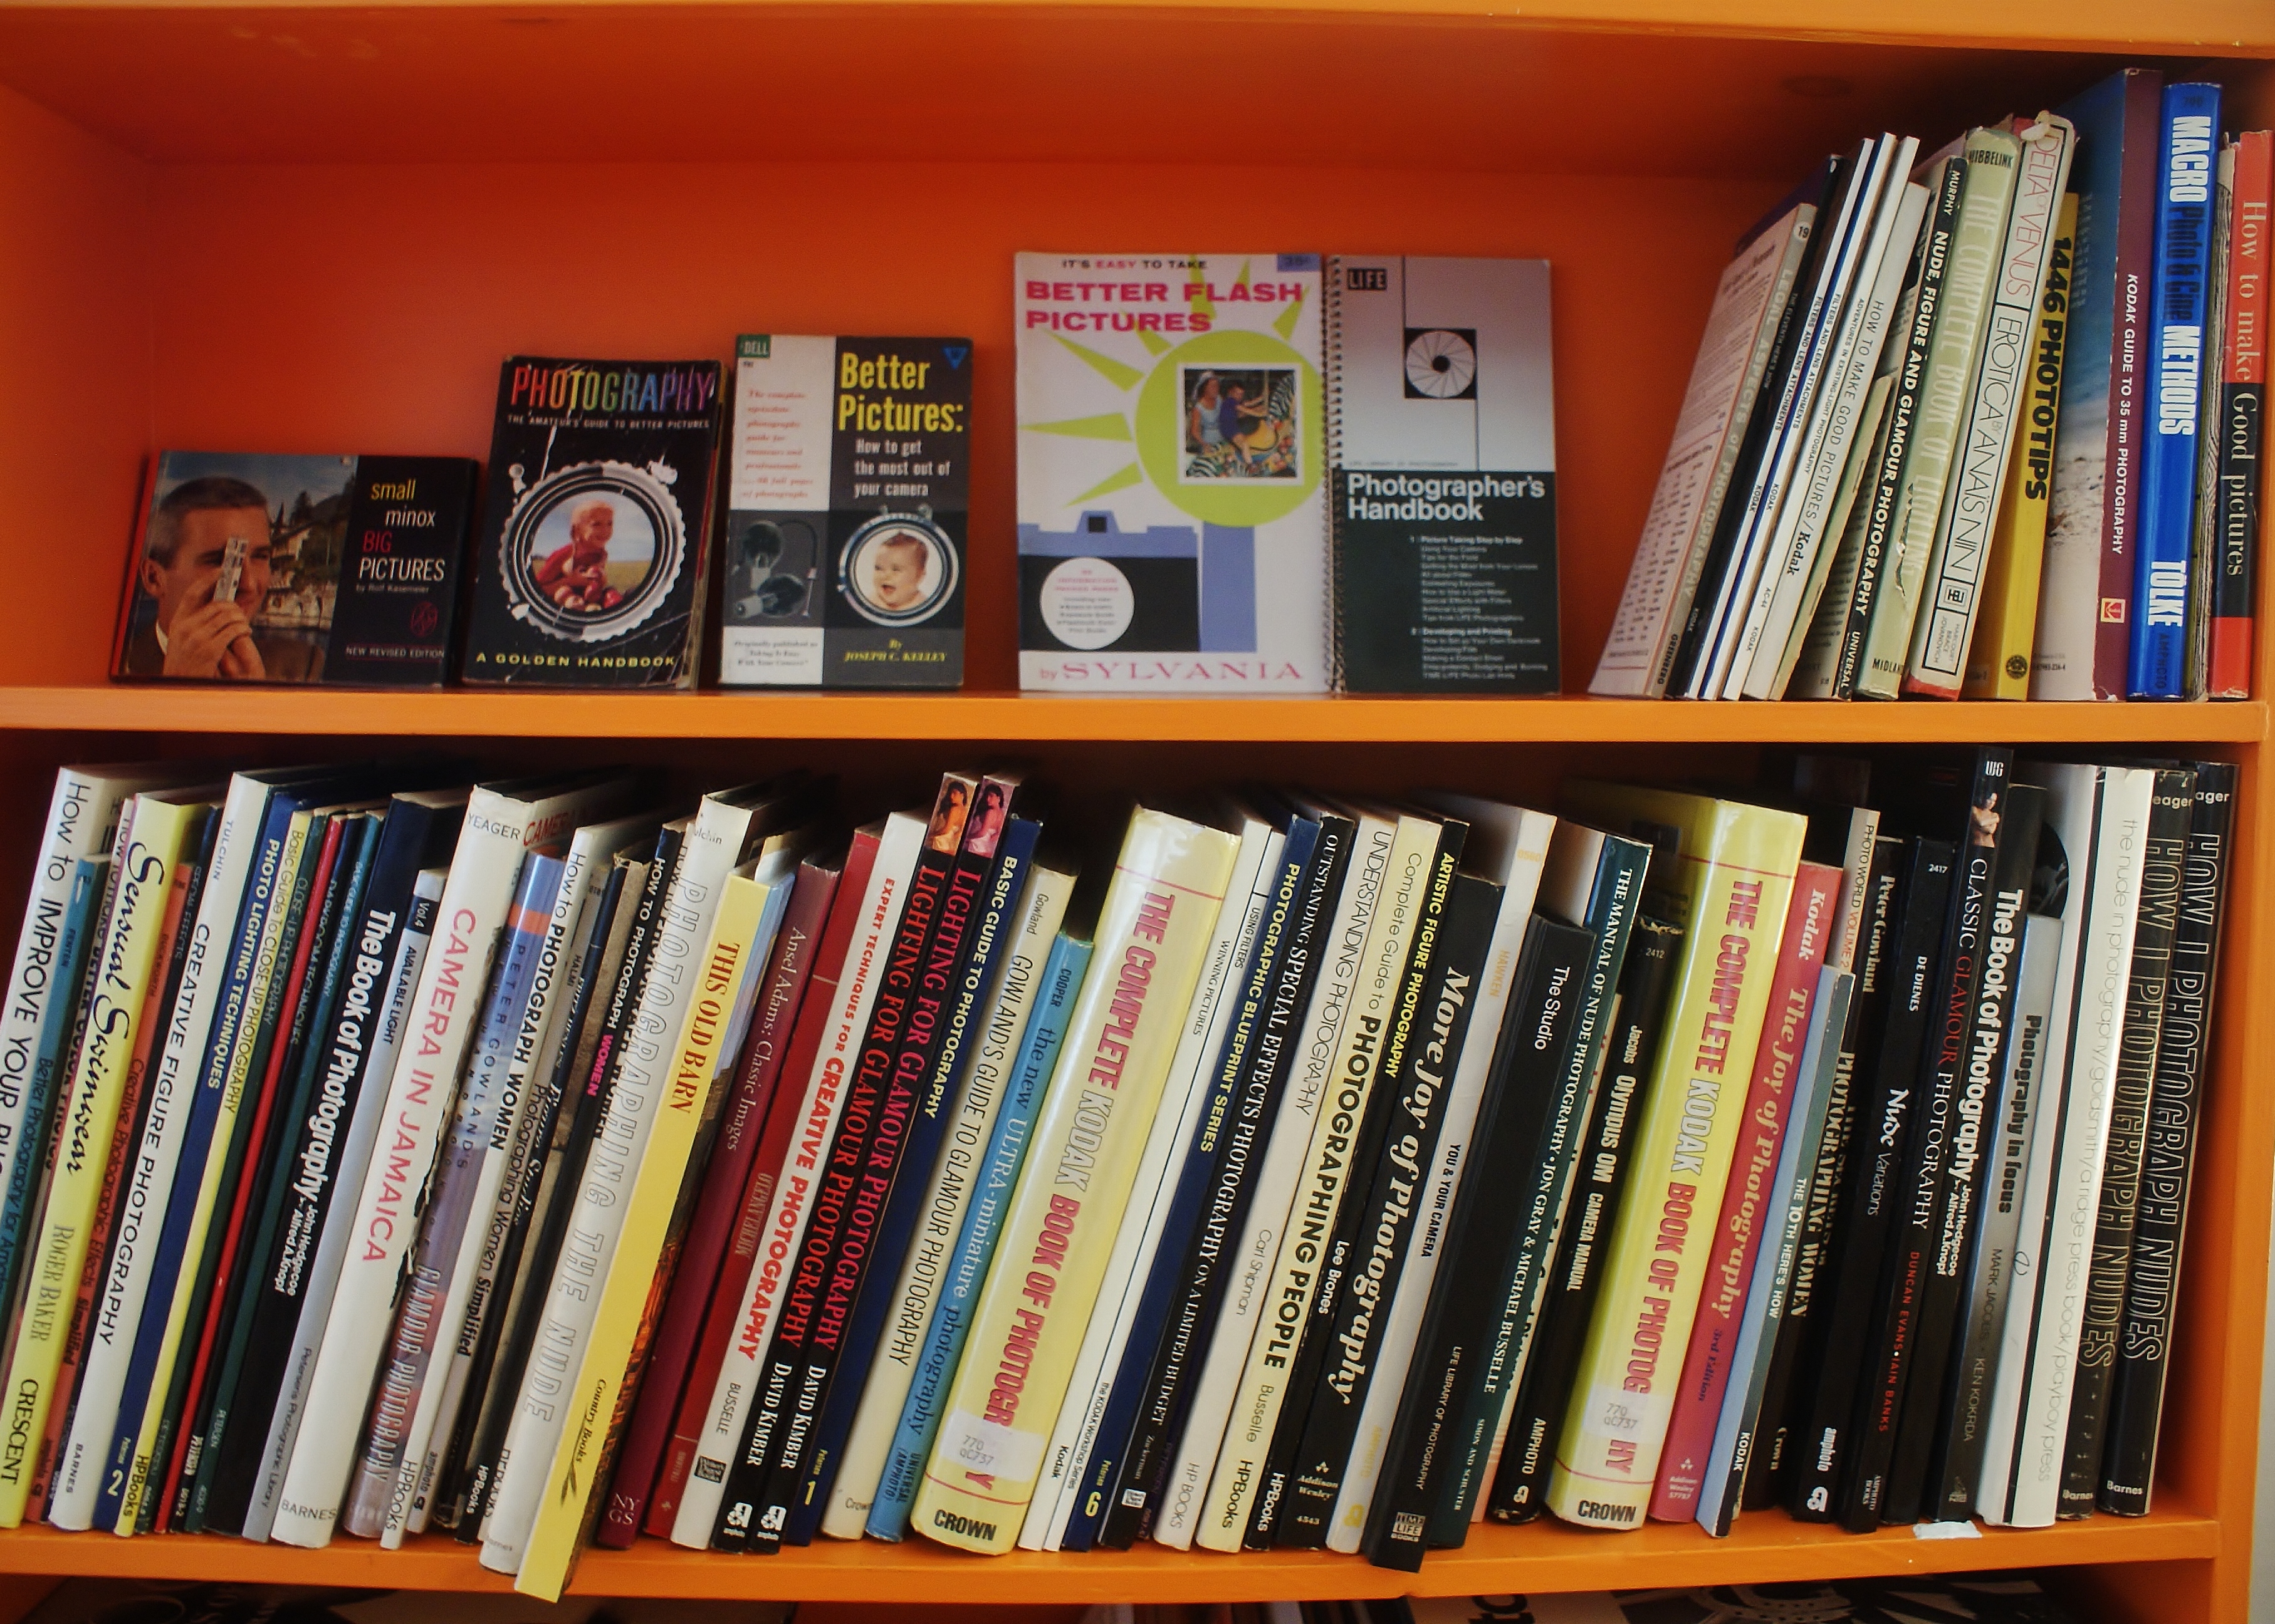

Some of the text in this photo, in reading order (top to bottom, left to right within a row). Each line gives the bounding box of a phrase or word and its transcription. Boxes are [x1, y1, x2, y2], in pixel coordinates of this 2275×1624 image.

[2024, 133, 2061, 197] DELTA
[1062, 260, 1207, 269] IT'S EASY TO TAKE
[1349, 269, 1387, 289] LIFE
[2005, 211, 2043, 298] VENUS
[1026, 281, 1302, 303] BETTER FLASH
[1026, 311, 1212, 333] PICTURES
[2234, 200, 2267, 382] How to make
[744, 340, 768, 356] DELL
[840, 351, 930, 390] Better
[1980, 316, 2023, 422] EROTICA
[2026, 237, 2073, 501] 1446 PHOTOTIPS
[2148, 115, 2212, 628] MACRO METHODS TOLKE
[511, 367, 714, 412] PHOTOGRAPHY
[838, 393, 964, 432] Pictures:
[1765, 293, 1841, 511] FILTERS AND LENS ATTACHMENTS KODAK
[2111, 274, 2139, 555] KODAK GUIDE TO 35 mm PHOTOGRAPHY
[508, 415, 524, 424] THE
[583, 419, 609, 428] GUIDE
[614, 419, 625, 428] TO
[630, 420, 662, 429] BETTER
[667, 419, 709, 429] PICTURES
[855, 438, 922, 458] How to get
[1786, 300, 1884, 576] HOW TO MAKE GOOD PICTURES Kodak
[1840, 170, 1961, 689] MURPHY NUDE, FIGURE AND GLAMOUR PHOTOGRAPHY UNIVERSAL
[370, 479, 416, 501] small
[854, 460, 951, 476] the most out of
[854, 482, 929, 499] your camera
[1347, 472, 1546, 502] Photographer's
[2219, 392, 2257, 578] Good pictures
[385, 508, 436, 529] minox
[1347, 498, 1484, 521] Handbook
[358, 557, 446, 582] PICTURES
[362, 531, 392, 553] BIG
[1952, 518, 1986, 573] NIN
[346, 646, 444, 658] NEW REVISED EDITION
[476, 653, 676, 668] A GOLDEN HANDBOOK
[1040, 662, 1303, 682] by SYLVANIA
[57, 782, 91, 844] How
[467, 813, 521, 841] YEAGER
[48, 855, 74, 882] to
[1841, 825, 1875, 968] PHOTO WORLD VOLUME 2
[14, 898, 63, 1023] IMPROVE
[208, 838, 280, 1089] PHOTO LIGHTING TECHNIQUES
[780, 927, 807, 974] Ansel
[1646, 948, 1665, 959] 2412
[66, 842, 165, 1172] Sensual Swimwear
[489, 853, 587, 1150] How to PHOTOGRAPH WOMEN
[669, 942, 739, 1110] THIS OLD BARN
[1200, 863, 1300, 1152] PHOTOGRAPHIC BLUEPRINT SERIES
[1534, 966, 1571, 1050] The Studio
[293, 910, 396, 1202] The Book of Photography
[745, 1040, 773, 1094] Classic
[1199, 835, 1338, 1263] OUTSTANDING SPECIAL EFFECTS PHOTOGRAPHY
[1912, 858, 1987, 1229] CLASSIC GLAMOUR PHOTOGRAPHY
[362, 909, 476, 1261] CAMERA IN JAMAICA
[779, 865, 946, 1348] LIGHTING FOR GLAMOUR PHOTOGRAPHY
[1022, 892, 1176, 1309] THE COMPLETE KODAK BOOK OF
[1648, 881, 1762, 1293] THE COMPLETE KODAK BOOK OF
[1711, 888, 1826, 1319] Kodak The Joy of Photography
[2124, 833, 2220, 1361] HOW I PHOTOGRAPH NUDES
[99, 924, 210, 1345] CREATIVE FIGURE PHOTOGRAPHY
[726, 1098, 756, 1150] Images
[738, 878, 895, 1361] EXPERT TECHNIQUES FOR CREATIVE PHOTOGRAPHY
[1263, 1014, 1381, 1368] PHOTOGRAPHING PEOPLE
[1327, 966, 1470, 1405] More Joy of Photography
[1, 1225, 75, 1485] ROGER BAKER CRESCENT
[746, 1361, 792, 1466] DAVID KIMBER
[66, 1444, 84, 1494] BARNES
[2106, 1481, 2143, 1495] Barnes
[281, 1498, 338, 1521] BARNES
[933, 1509, 997, 1542] CROWN
[1577, 1500, 1637, 1522] CROWN
